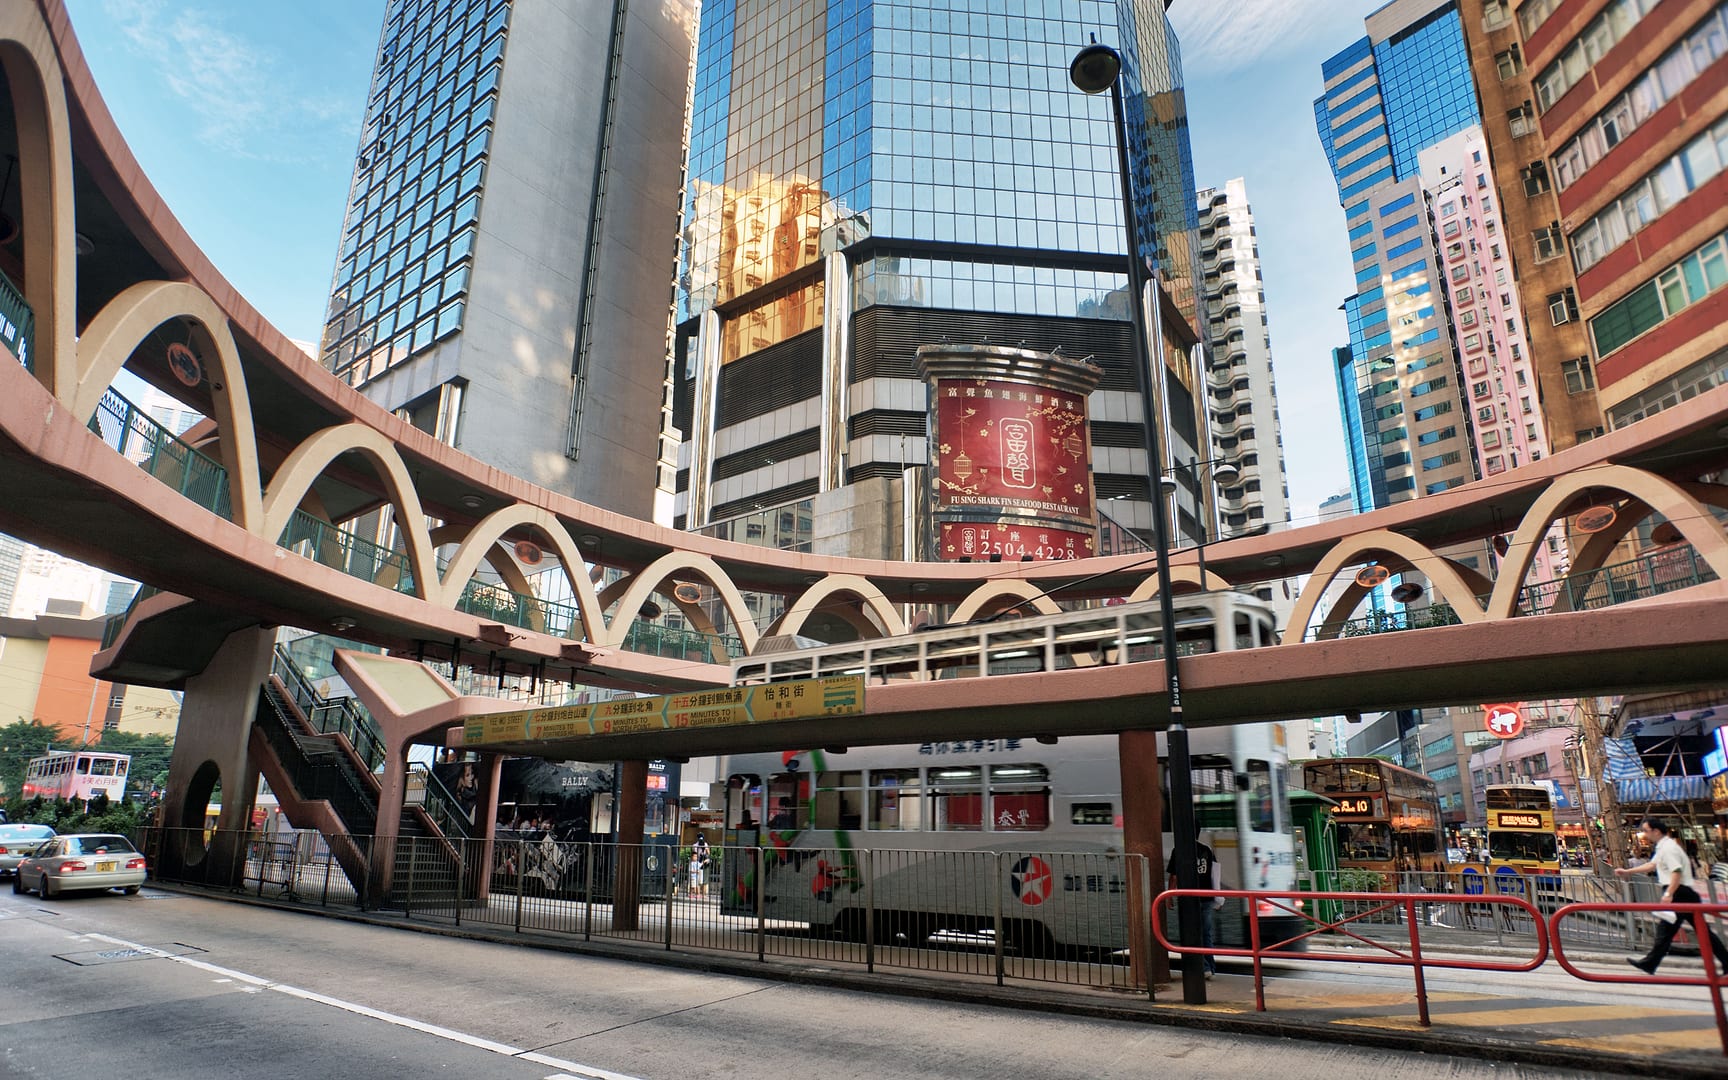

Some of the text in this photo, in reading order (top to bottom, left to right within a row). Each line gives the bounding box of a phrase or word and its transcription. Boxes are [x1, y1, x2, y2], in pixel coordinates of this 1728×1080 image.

[951, 495, 960, 504] FU
[960, 496, 977, 504] SING
[977, 497, 1000, 505] SHARK
[1012, 499, 1042, 509] SEAFOOD
[1042, 502, 1079, 514] RESTAURANT
[765, 685, 804, 700] 怡和街
[675, 712, 688, 727] 15
[690, 711, 720, 719] MINUTES
[536, 726, 542, 737] 7
[604, 720, 611, 733] 9
[562, 777, 589, 786] BALLY
[1357, 800, 1368, 812] 10
